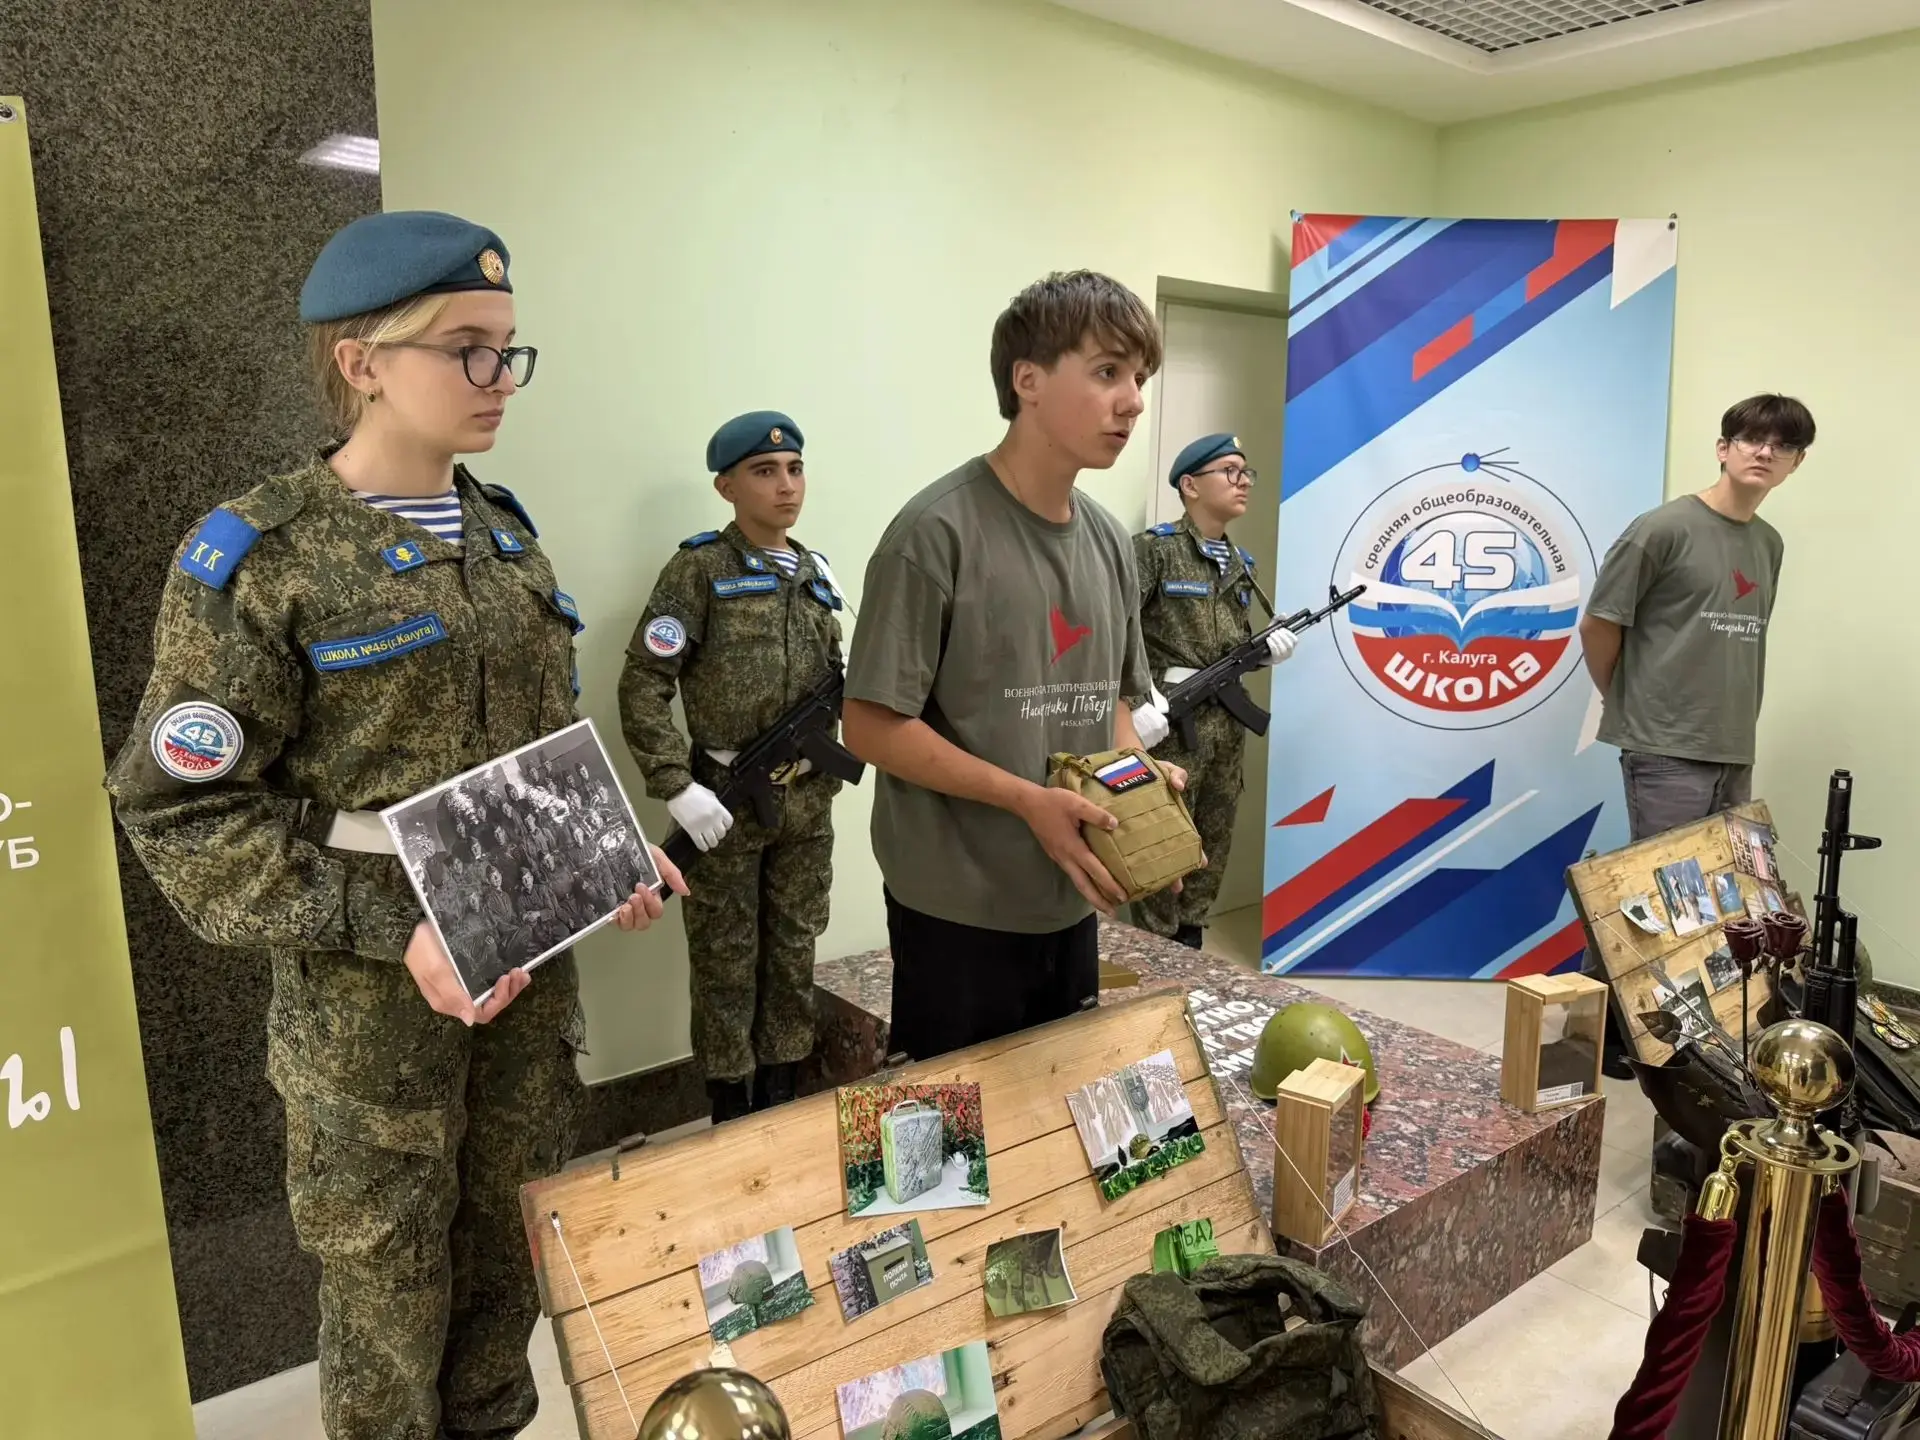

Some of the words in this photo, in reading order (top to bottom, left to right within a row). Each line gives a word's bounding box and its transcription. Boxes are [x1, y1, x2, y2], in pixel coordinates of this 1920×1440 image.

[1364, 513, 1411, 571] средняя
[1412, 488, 1566, 574] общеобразовательная
[1400, 529, 1517, 591] 45
[658, 626, 675, 637] 45
[319, 647, 360, 662] ШКОЛА
[1422, 653, 1435, 664] г.
[1438, 650, 1498, 667] Калуга
[184, 725, 217, 745] 45
[1116, 773, 1149, 789] КАЛУГА
[0, 836, 40, 870] Б
